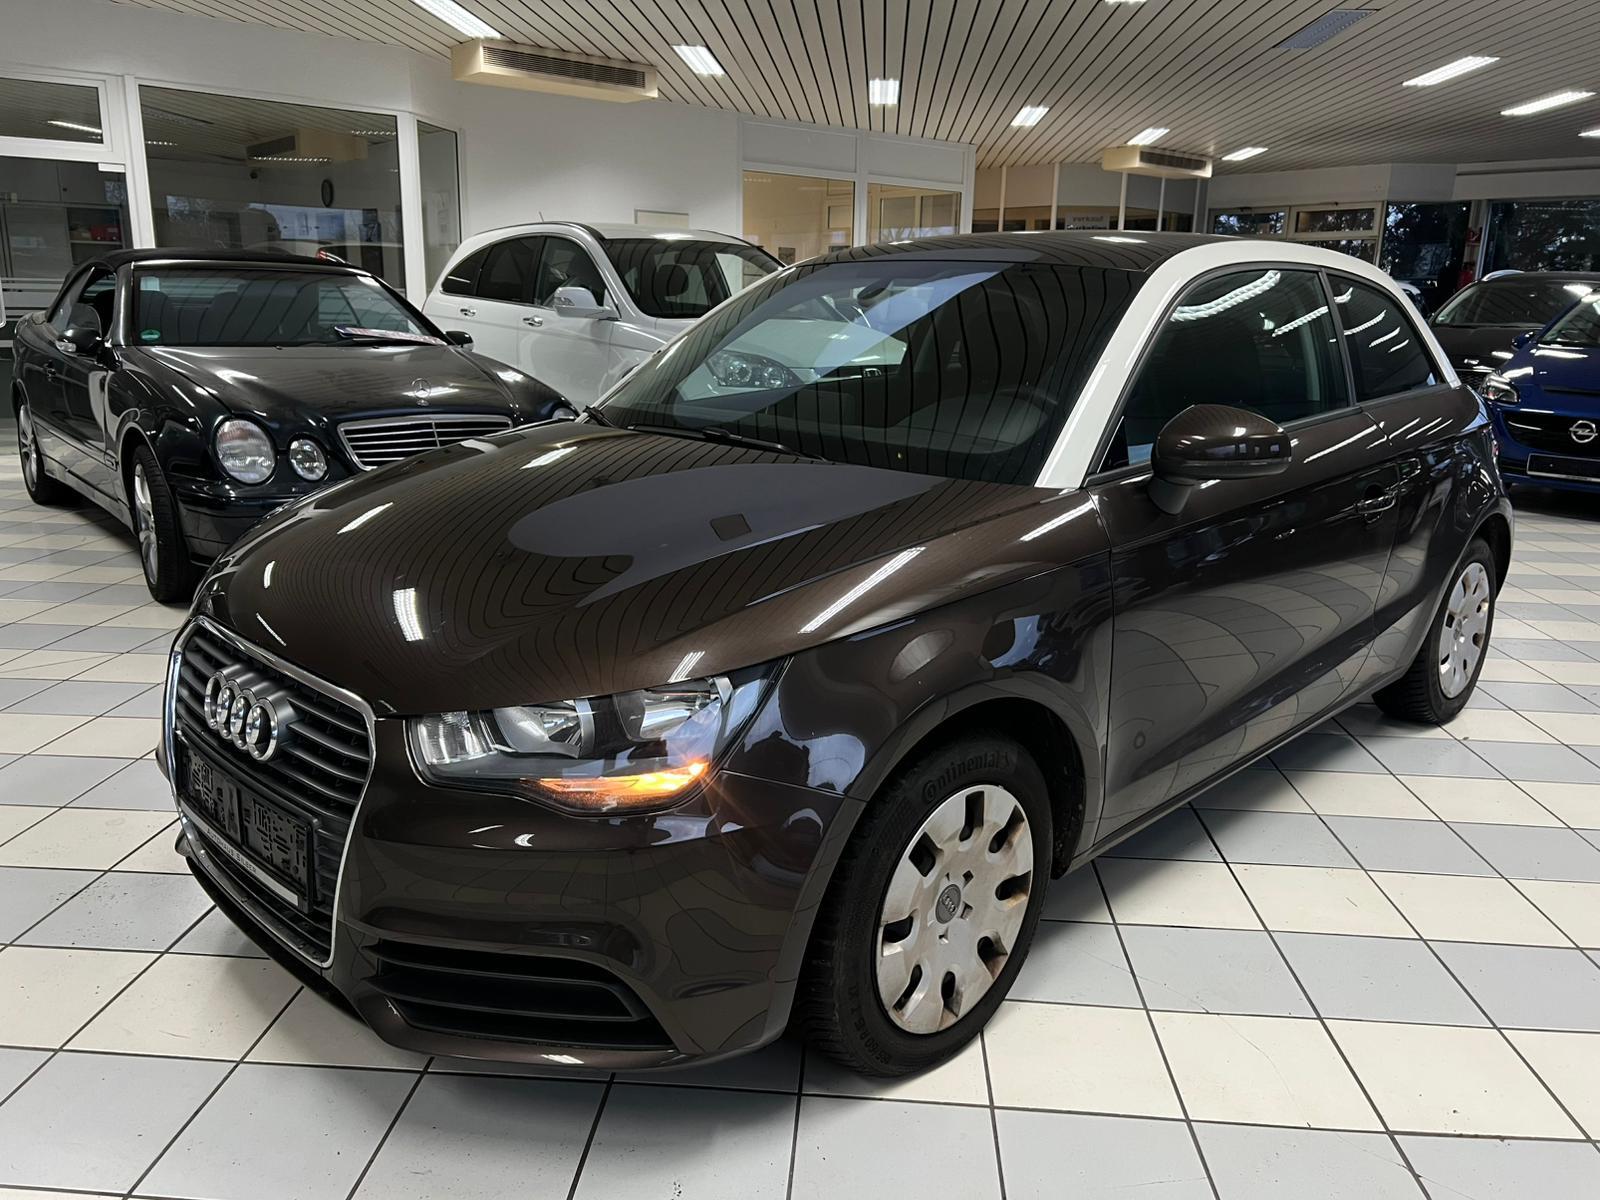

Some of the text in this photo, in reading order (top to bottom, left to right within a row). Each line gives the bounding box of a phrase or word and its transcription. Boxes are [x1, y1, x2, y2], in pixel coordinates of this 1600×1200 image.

[921, 750, 1000, 803] Continental
[206, 828, 257, 873] AUTOHAUS SILBER
